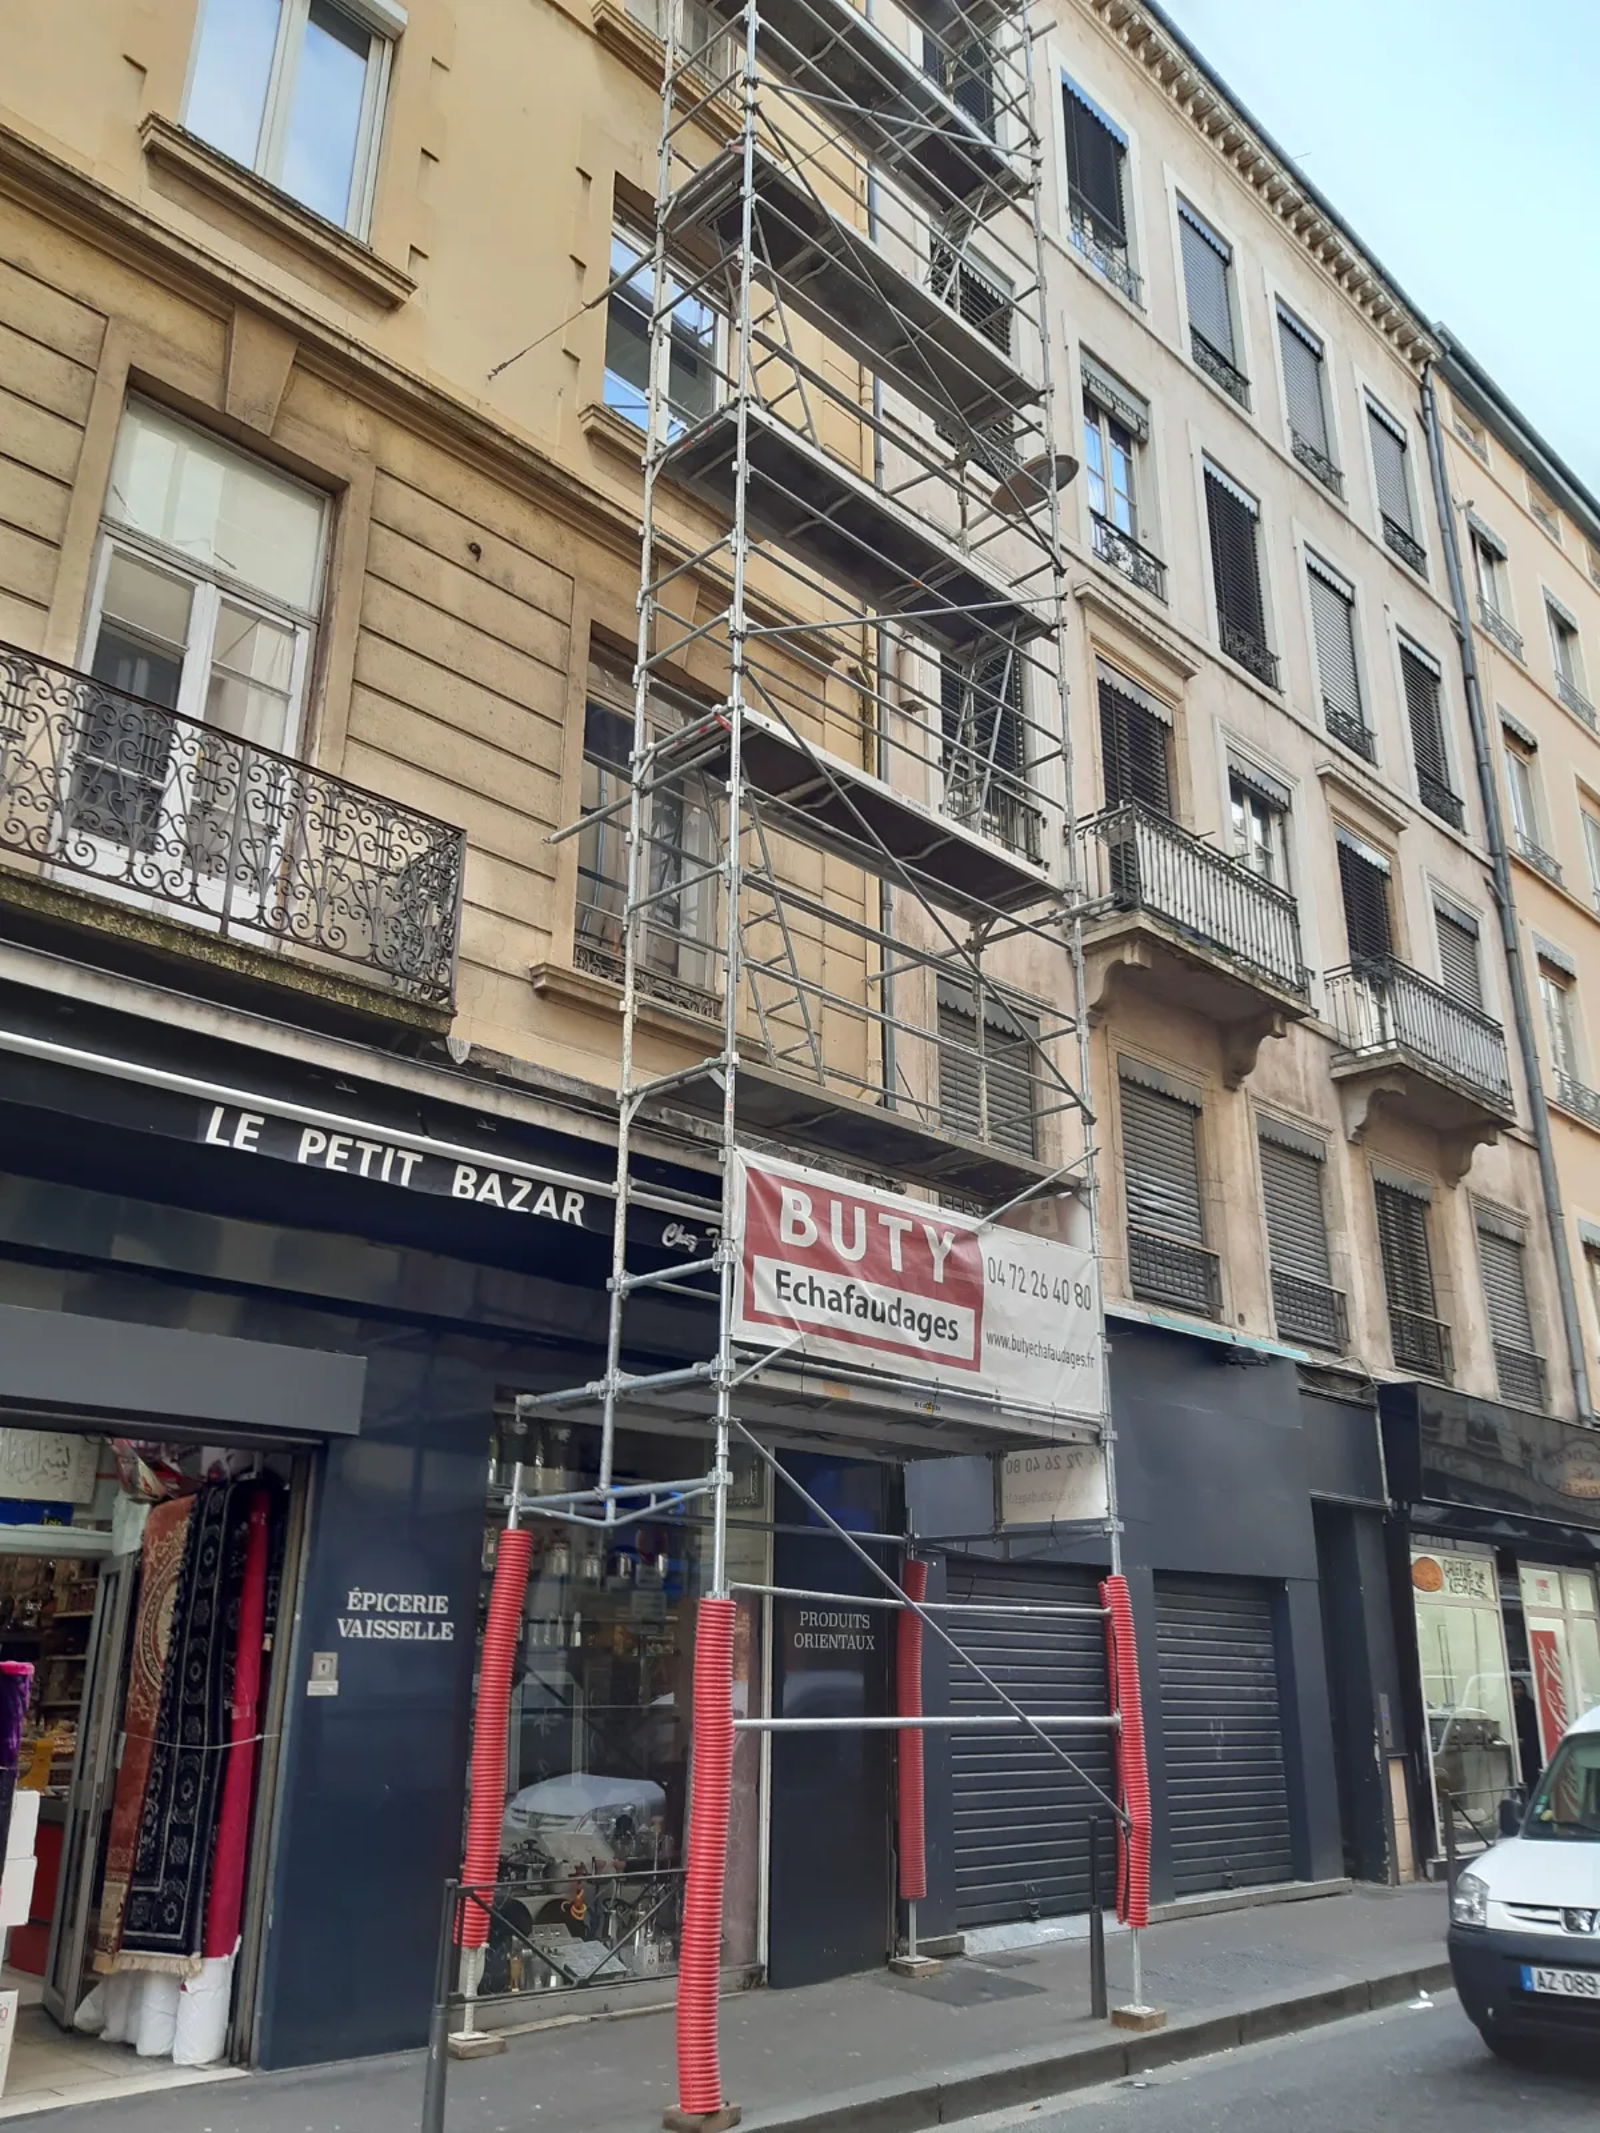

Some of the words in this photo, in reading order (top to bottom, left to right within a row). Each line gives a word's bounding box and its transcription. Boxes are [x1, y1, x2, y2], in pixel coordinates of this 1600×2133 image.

[205, 1106, 266, 1153] LE
[297, 1128, 423, 1187] PETIT
[451, 1165, 585, 1226] BAZAR
[780, 1186, 956, 1284] BUTY
[987, 1256, 1006, 1287] 04
[1009, 1262, 1027, 1294] 72
[1031, 1270, 1048, 1300] 26
[1053, 1277, 1070, 1306] 40
[1073, 1282, 1092, 1311] 80
[775, 1268, 959, 1343] Echafaudages
[986, 1331, 1095, 1370] www.butyechafaudages.fr
[346, 1586, 449, 1614] ÉPICERIE
[337, 1618, 455, 1641] VAISSELLE
[800, 1611, 871, 1629] PRODUITS
[793, 1632, 876, 1650] ORIENTAUX
